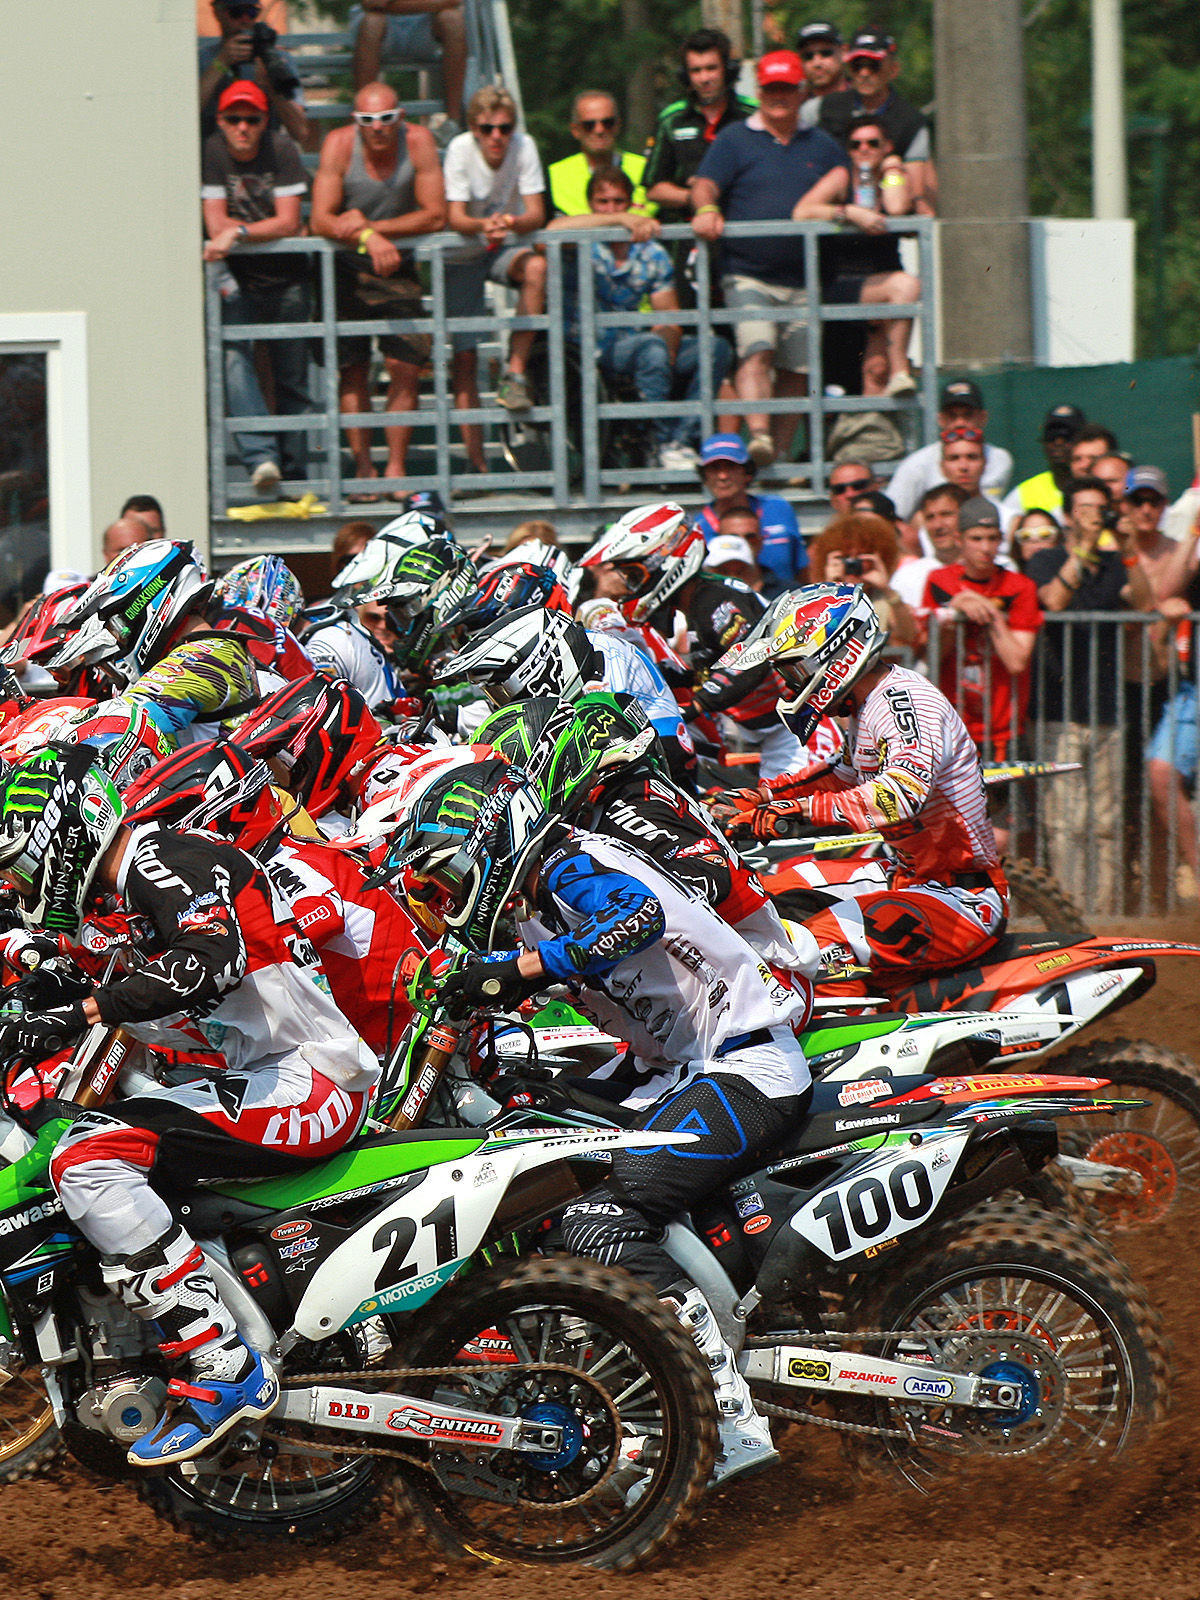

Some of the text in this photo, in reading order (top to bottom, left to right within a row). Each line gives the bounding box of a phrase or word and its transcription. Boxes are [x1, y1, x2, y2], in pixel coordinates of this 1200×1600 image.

[517, 618, 564, 680] SCOTT
[815, 620, 857, 663] SCOTT
[806, 637, 866, 713] Red Bull
[466, 788, 506, 855] SCOTT
[476, 856, 508, 924] MONSTER
[1111, 942, 1171, 952] DUNLOP
[431, 1033, 455, 1048] GET
[91, 1040, 126, 1095] SFF AIR
[403, 1063, 438, 1120] SFF AIR
[972, 1079, 1043, 1091] PIRELLI
[834, 1113, 901, 1132] Kawasaki
[542, 1135, 620, 1148] DUNLOP
[812, 1159, 934, 1255] 100
[276, 1222, 307, 1238] Twin Air
[279, 1239, 319, 1258] VERTEX
[372, 1195, 459, 1293] 21
[378, 1271, 444, 1307] MOTOREX
[837, 1370, 898, 1385] BRAKING
[911, 1382, 947, 1395] AFAM
[328, 1402, 371, 1420] D.I.D
